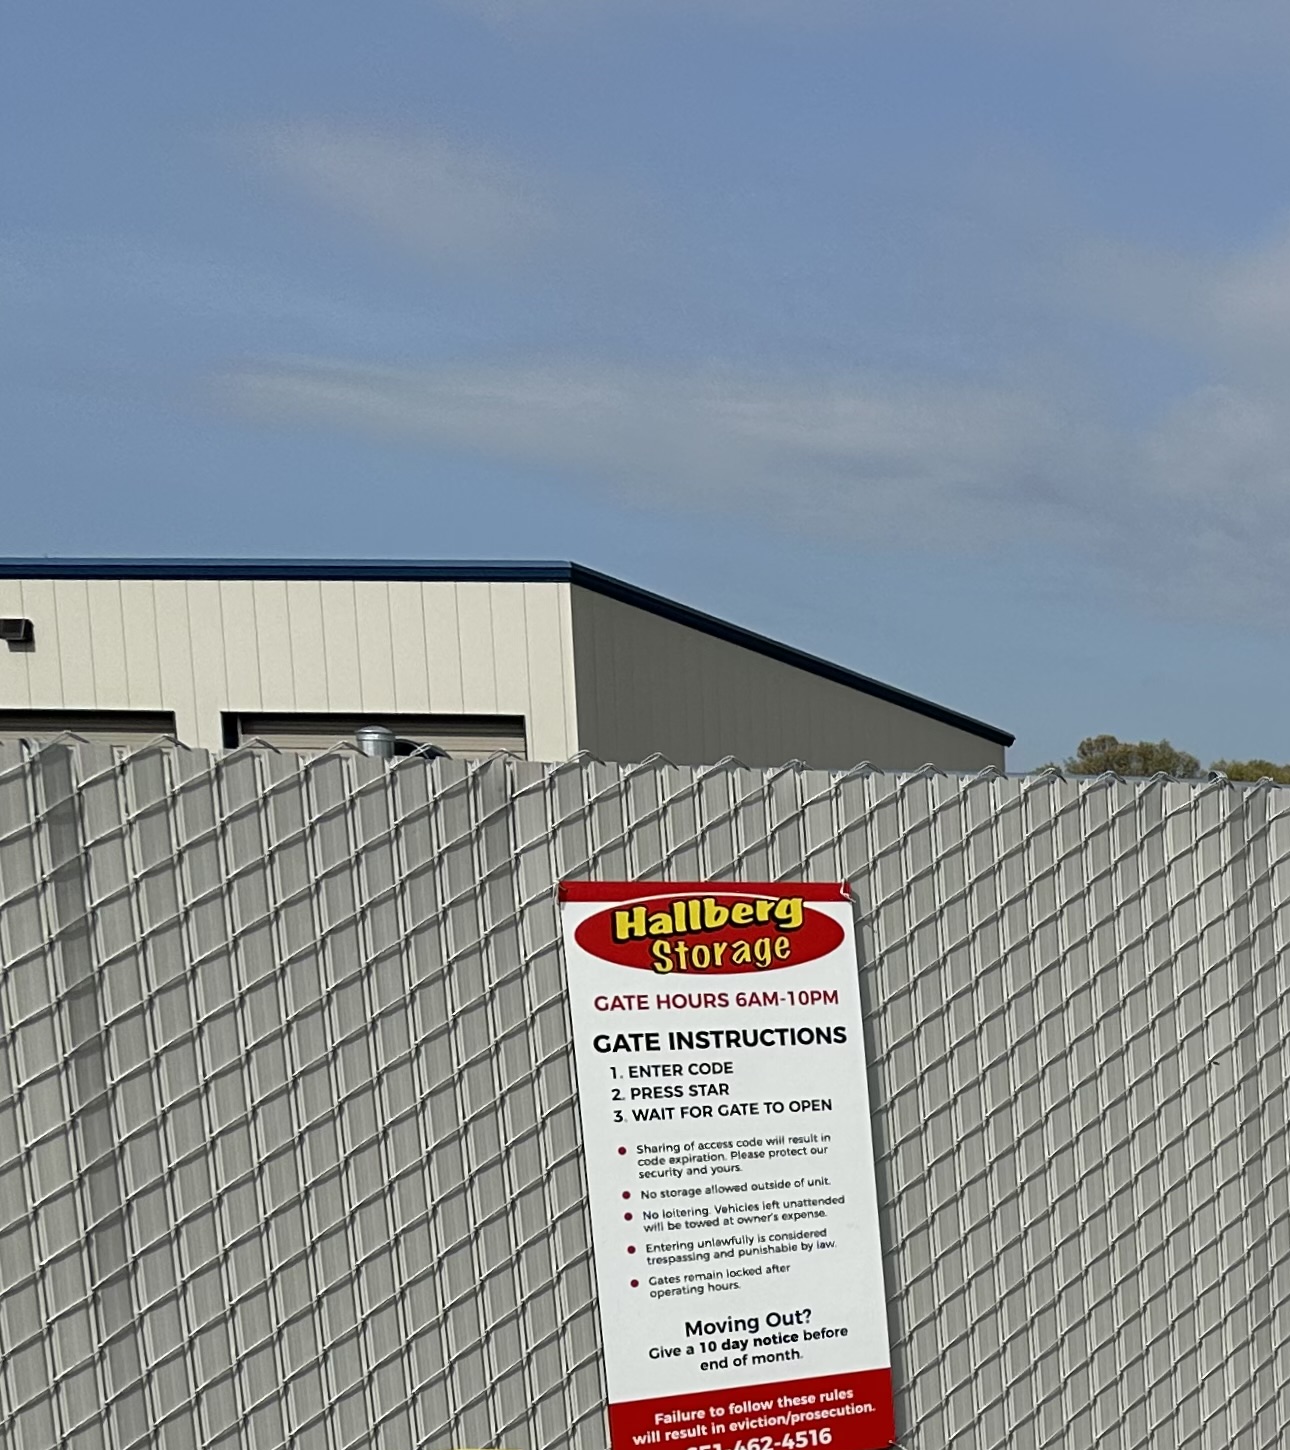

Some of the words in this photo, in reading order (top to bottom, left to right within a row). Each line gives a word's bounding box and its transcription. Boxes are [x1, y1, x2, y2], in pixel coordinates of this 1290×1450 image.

[613, 895, 806, 942] Hallberg
[651, 934, 792, 974] Storage
[594, 995, 650, 1011] GATE
[657, 993, 730, 1010] HOURS
[736, 990, 839, 1007] 6AM-10PM
[593, 1033, 661, 1053] GATE
[669, 1026, 847, 1050] INSTRUCTIONS
[610, 1067, 623, 1079] 1.
[629, 1064, 684, 1078] ENTER
[688, 1062, 734, 1075] CODE
[612, 1089, 626, 1101] 2.
[631, 1086, 684, 1100] PRESS
[689, 1083, 730, 1097] STAR
[614, 1110, 628, 1123] 3.
[632, 1107, 675, 1122] WAIT
[681, 1106, 713, 1119] FOR
[718, 1103, 759, 1117] GATE
[763, 1102, 784, 1114] TO
[789, 1099, 832, 1112] OPEN
[636, 1142, 680, 1154] Sharing
[683, 1140, 695, 1151] of
[697, 1140, 733, 1150] access
[736, 1137, 763, 1147] code
[765, 1135, 785, 1145] will
[788, 1133, 818, 1144] result
[820, 1133, 831, 1142] in
[637, 1155, 666, 1166] code
[668, 1152, 727, 1165] expiration.
[730, 1150, 765, 1160] Please
[768, 1146, 808, 1159] protect
[810, 1146, 828, 1155] our
[638, 1167, 683, 1179] security
[686, 1164, 708, 1175] and
[710, 1164, 742, 1176] yours.
[640, 1190, 657, 1199] No
[660, 1187, 702, 1198] storage
[704, 1182, 748, 1194] allowed
[750, 1179, 791, 1191] outside
[793, 1177, 805, 1188] of
[807, 1176, 831, 1187] unit.
[642, 1210, 659, 1220] No
[662, 1207, 711, 1219] loitering.
[714, 1202, 759, 1214] Vehicles
[762, 1199, 780, 1210] left
[782, 1194, 845, 1209] unattended
[643, 1221, 664, 1232] will
[667, 1221, 682, 1230] be
[684, 1216, 720, 1229] towed
[723, 1216, 734, 1226] at
[736, 1212, 779, 1224] owner's
[781, 1210, 827, 1221] expense.
[645, 1241, 694, 1253] Entering
[697, 1234, 754, 1248] unlawfully
[757, 1233, 766, 1243] is
[768, 1227, 827, 1241] considered
[646, 1252, 710, 1265] trespassing
[713, 1247, 734, 1259] and
[738, 1242, 798, 1258] punishable
[800, 1241, 813, 1252] by
[816, 1240, 836, 1249] law.
[648, 1275, 681, 1286] Gates
[683, 1270, 723, 1282] remain
[726, 1265, 762, 1278] locked
[765, 1263, 791, 1274] after
[649, 1285, 704, 1299] operating
[707, 1281, 741, 1292] hours.
[685, 1316, 759, 1337] Moving
[766, 1309, 812, 1328] Out?
[649, 1346, 682, 1359] Give
[686, 1346, 695, 1355] a
[700, 1341, 717, 1353] 10
[722, 1339, 748, 1351] day
[753, 1332, 799, 1347] notice
[803, 1327, 848, 1341] before
[701, 1357, 728, 1371] end
[733, 1354, 748, 1367] of
[752, 1348, 803, 1365] month.
[655, 1410, 705, 1425] Failure
[710, 1407, 725, 1417] to
[729, 1401, 773, 1414] follow
[778, 1395, 816, 1408] these
[820, 1389, 853, 1402] rules
[633, 1431, 660, 1445] will
[666, 1425, 707, 1441] result
[712, 1423, 725, 1434] in
[730, 1403, 875, 1431] eviction/prosecution.
